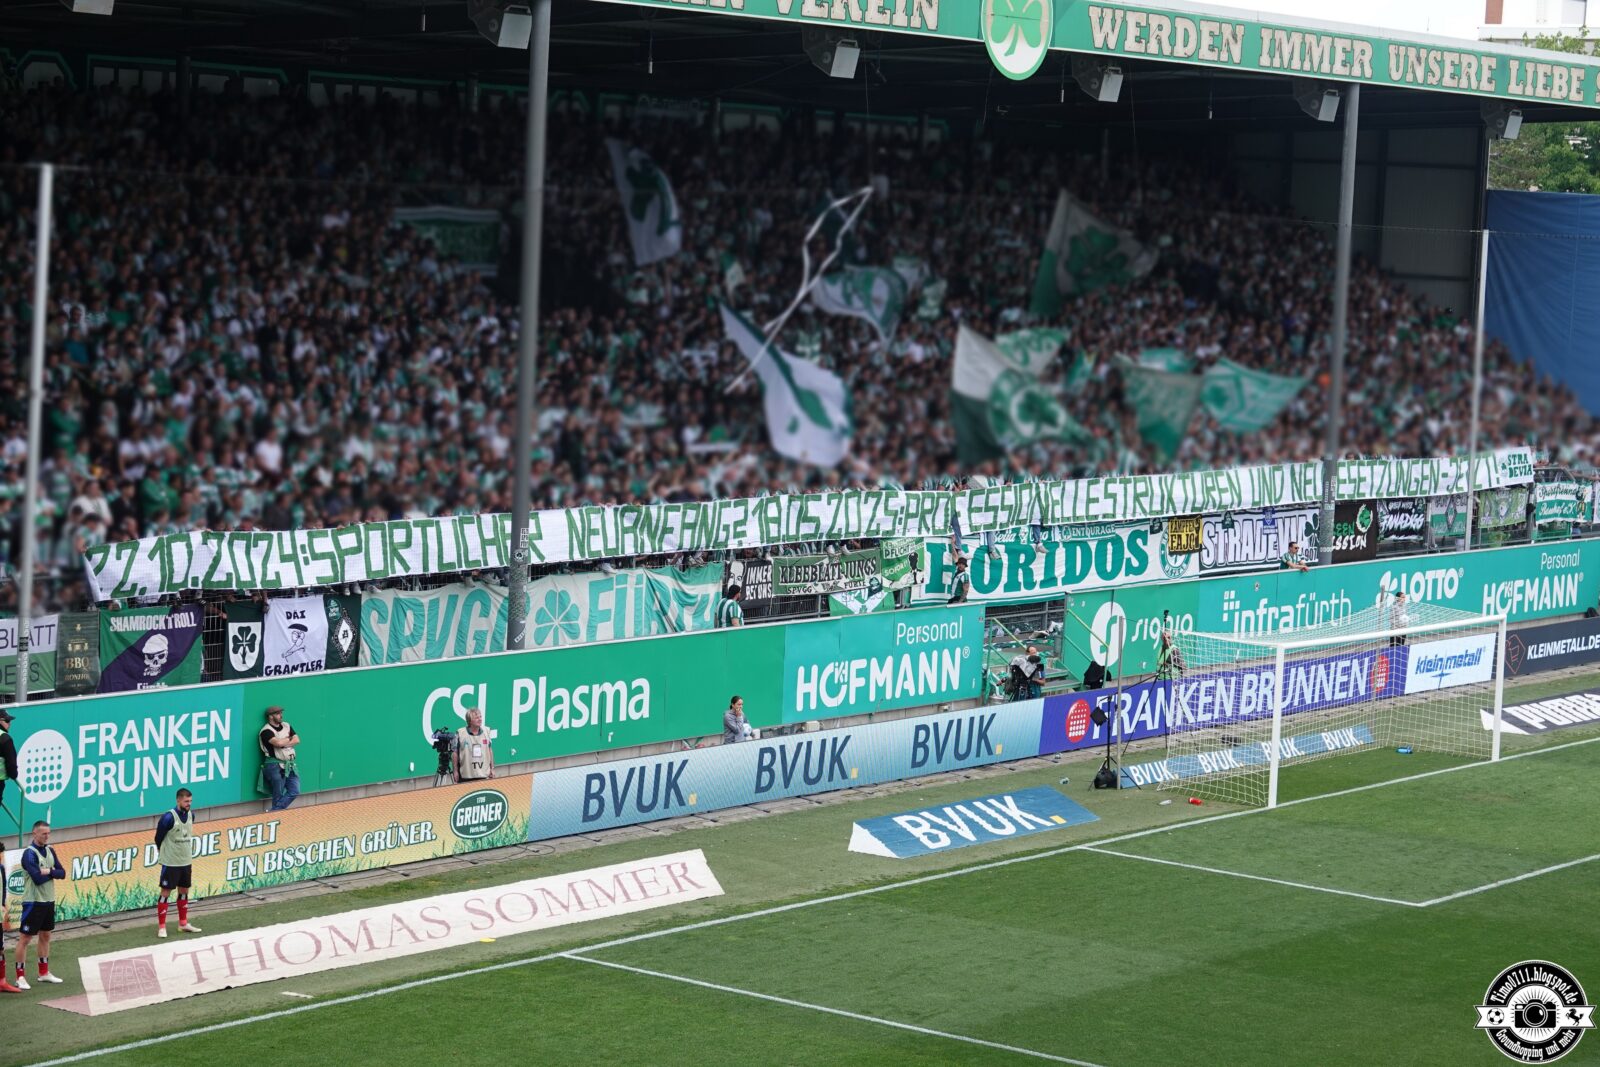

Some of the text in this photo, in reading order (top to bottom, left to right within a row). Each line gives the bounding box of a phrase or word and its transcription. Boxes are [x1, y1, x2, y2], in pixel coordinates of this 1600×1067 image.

[1088, 6, 1245, 64] WERDEN
[1259, 27, 1373, 79] IMMER
[1388, 44, 1497, 92] UNSERE
[1508, 59, 1586, 102] LIEBE
[1507, 453, 1529, 465] STRA
[1507, 464, 1533, 478] DEVIA
[1250, 465, 1284, 506] UND
[1072, 523, 1116, 537] ENTOURAGE
[746, 565, 772, 584] IMMER
[1541, 549, 1581, 570] Personal
[1400, 568, 1459, 602] LOTTO
[896, 615, 963, 646] Personal
[64, 657, 90, 671] BBQ
[265, 659, 323, 676] GRANTLER
[422, 676, 650, 746] CSL Plasma
[78, 708, 231, 759] FRANKEN
[77, 746, 230, 798] BRUNNEN
[471, 761, 484, 770] TV
[72, 847, 138, 880] MACH'
[228, 820, 281, 851] WELT
[226, 820, 438, 882] EIN BISSCHEN GRÜNER.
[171, 861, 709, 986] THOMAS SOMMER
